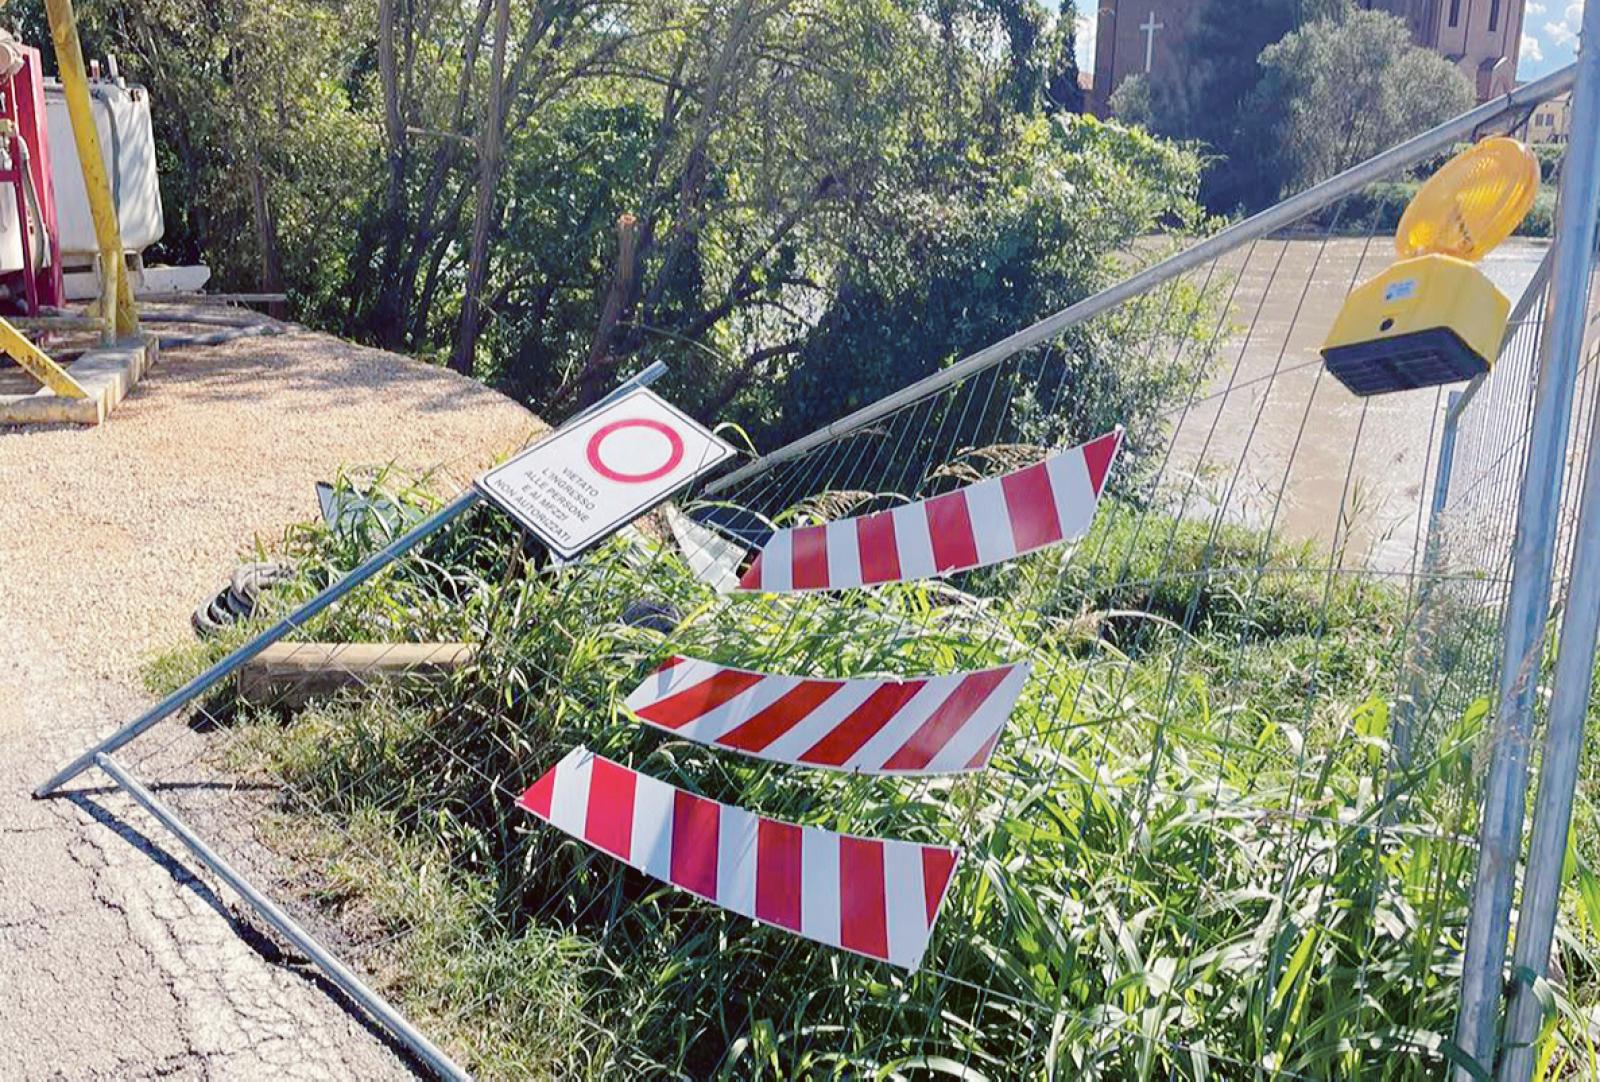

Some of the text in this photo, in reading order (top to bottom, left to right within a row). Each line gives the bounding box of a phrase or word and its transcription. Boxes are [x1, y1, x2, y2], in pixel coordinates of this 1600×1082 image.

[524, 470, 590, 522] ALLE PERSONE
[541, 467, 596, 510] L'INGRESSO
[562, 467, 599, 497] VIETATO
[494, 479, 572, 542] NON AUTORIZZATI
[539, 498, 569, 521] MEZZI
